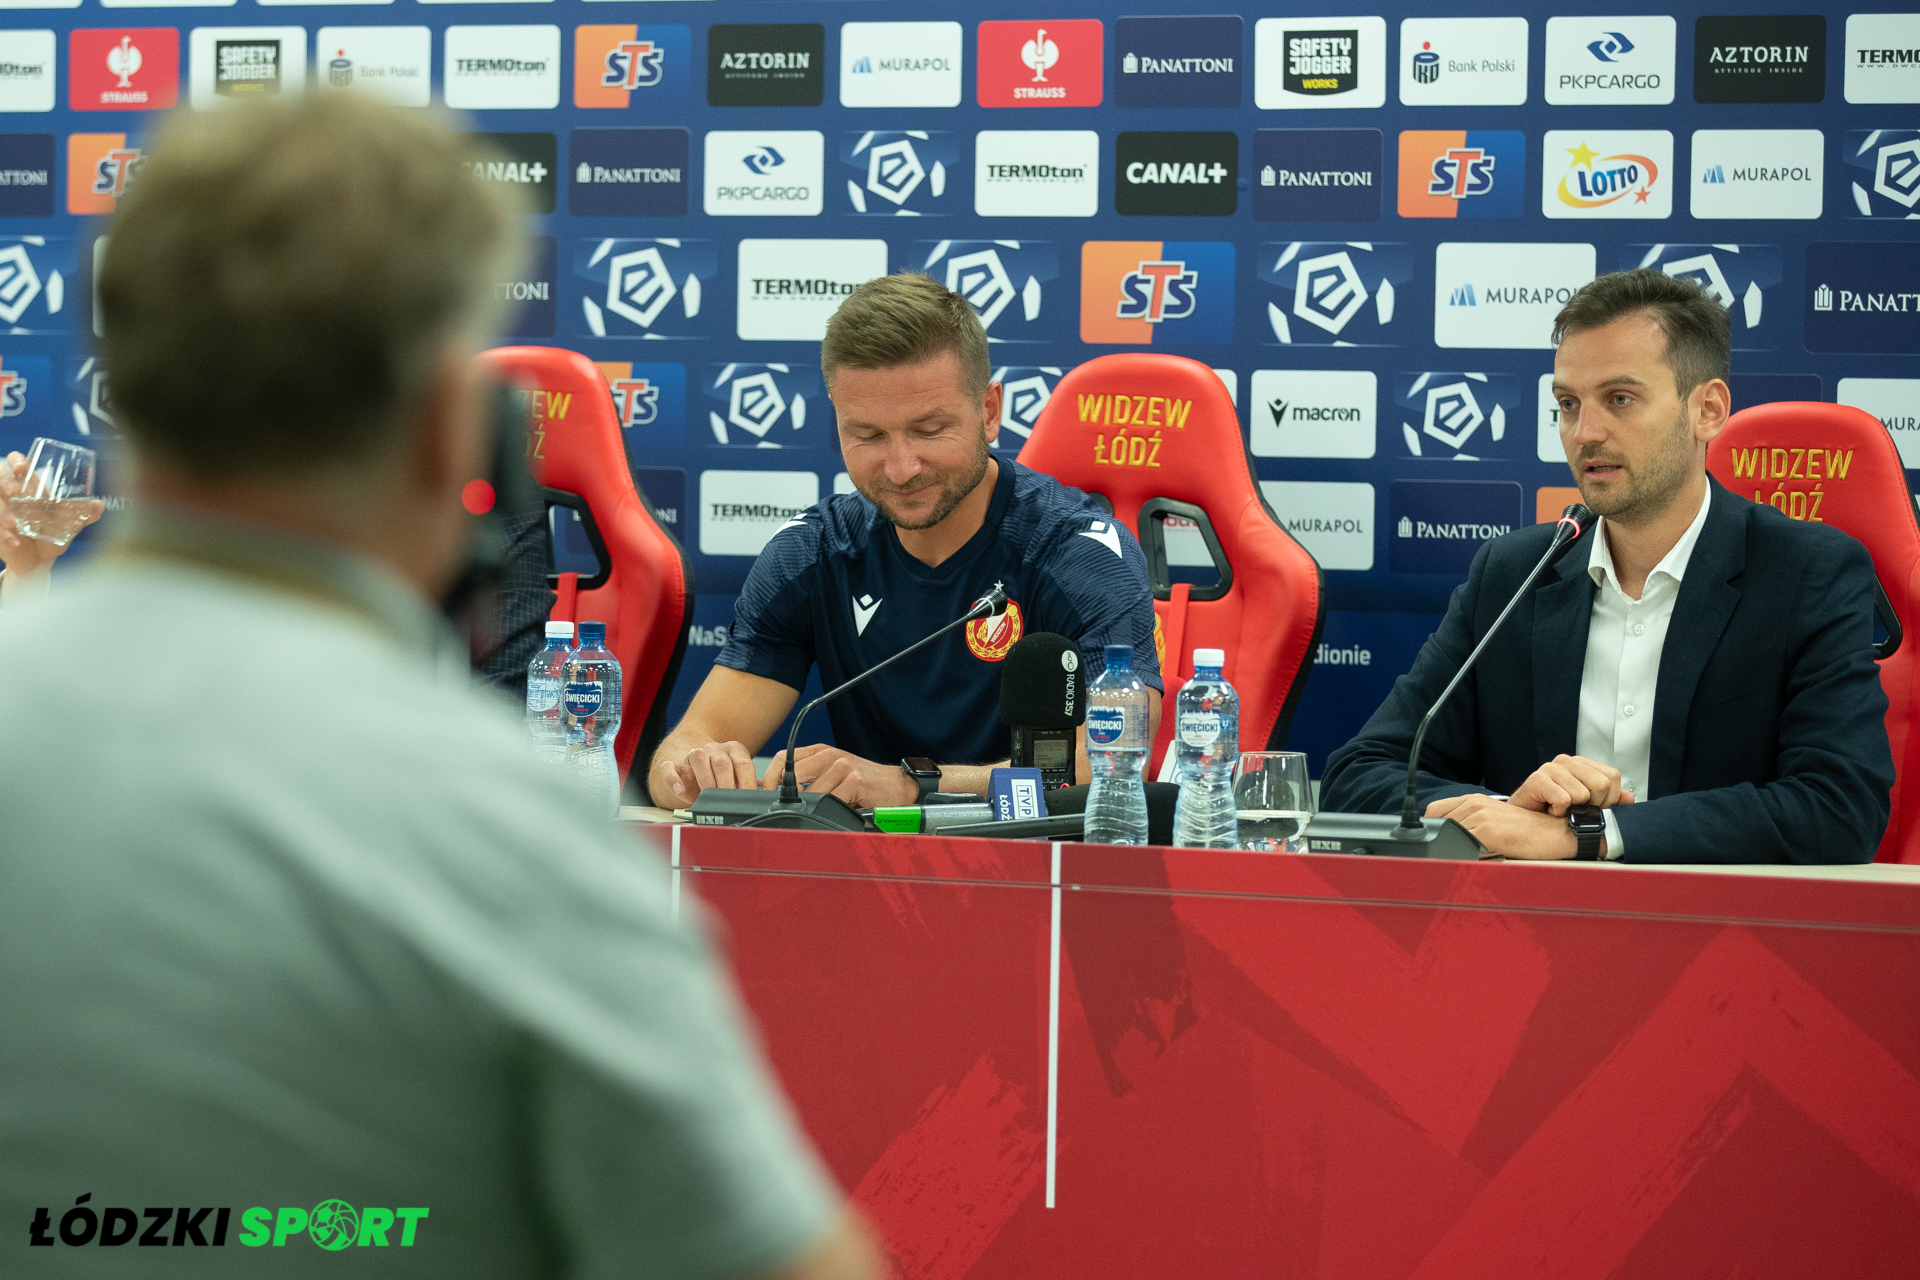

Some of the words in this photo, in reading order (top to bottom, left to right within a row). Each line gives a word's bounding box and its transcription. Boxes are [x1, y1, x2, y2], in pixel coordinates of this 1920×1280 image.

[218, 46, 278, 64] SAFETY
[1289, 38, 1352, 57] SAFETY
[1709, 46, 1810, 64] AZTORIN
[456, 59, 546, 72] TERMOton
[602, 41, 665, 91] STS
[720, 52, 811, 70] AZTORIN
[878, 57, 952, 72] MURAPOL
[1141, 56, 1234, 74] PANATTONI
[1289, 56, 1352, 75] JOGGER
[1448, 60, 1478, 73] Bank
[1482, 60, 1516, 73] Polski
[218, 64, 277, 80] JOGGER
[1302, 78, 1339, 89] WORKS
[1559, 74, 1661, 90] PKPCARGO
[100, 91, 148, 103] STRAUSS
[1013, 87, 1066, 99] STRAUSS
[593, 166, 681, 184] PANATTONI
[987, 164, 1083, 178] TERMOton
[1126, 162, 1228, 184] CANAL+
[1279, 169, 1373, 187] PANATTONI
[1428, 148, 1496, 199] STS
[1733, 167, 1812, 182] MURAPOL
[1577, 165, 1638, 198] LOTTO
[717, 186, 810, 201] PKPCARGO
[1117, 260, 1199, 323] STS
[1077, 394, 1192, 429] WIDZEW
[1293, 406, 1361, 422] macron
[1094, 428, 1163, 469] ŁÓDŹ
[1731, 447, 1854, 480] WIDZEW
[1288, 518, 1363, 533] MURAPOL
[1416, 522, 1511, 540] PANATTONI
[565, 691, 600, 704] ŚWIĘCICKI
[1181, 720, 1218, 734] ŚWIĘCICKI
[999, 794, 1013, 820] ŁÓDŹ
[1019, 787, 1032, 815] TVP
